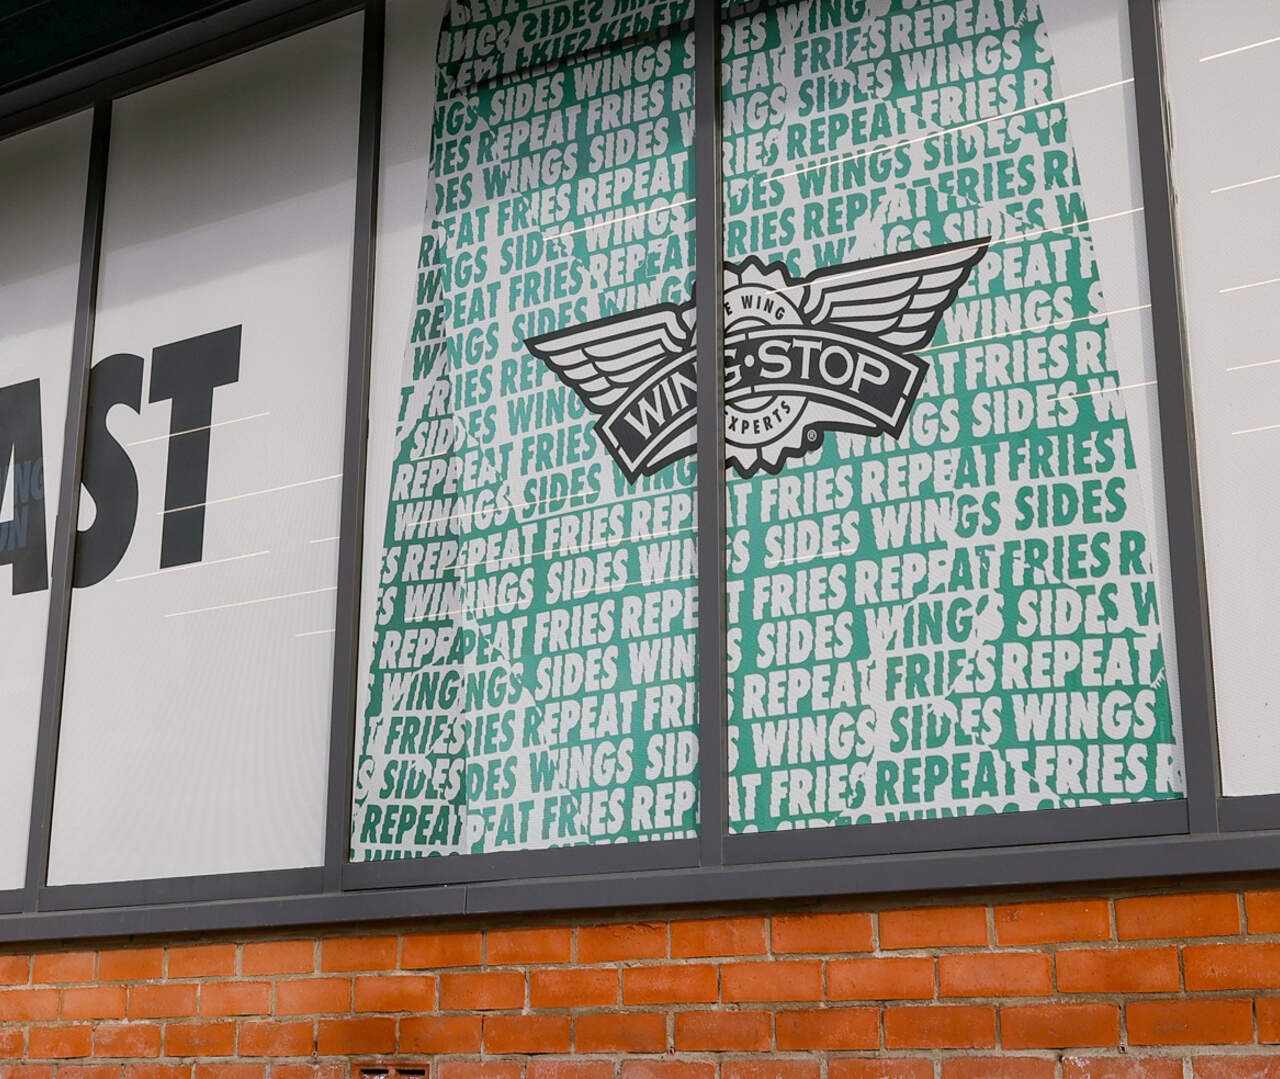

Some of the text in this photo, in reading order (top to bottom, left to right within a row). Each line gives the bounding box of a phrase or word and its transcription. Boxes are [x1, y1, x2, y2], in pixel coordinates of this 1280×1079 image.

[489, 73, 565, 127] SIDES
[573, 42, 672, 100] WINGS
[587, 80, 666, 136] FRIES
[588, 117, 669, 174] SIDES
[902, 29, 1021, 91] WINGS
[576, 151, 687, 217] REPEAT
[741, 294, 786, 321] WING
[942, 286, 1074, 346] WINGS
[519, 420, 597, 477] FRIES
[965, 334, 1071, 391] FRIES
[971, 380, 1080, 438] SIDES
[544, 500, 625, 561] FRIES
[760, 465, 854, 523] FRIES
[546, 548, 629, 605] SIDES
[765, 510, 861, 572] SIDES
[1014, 476, 1128, 532] SIDES
[533, 600, 615, 656] FRIES
[753, 563, 847, 620] FRIES
[536, 646, 618, 702] SIDES
[756, 611, 854, 670] SIDES
[1001, 632, 1163, 690] REPEAT
[752, 709, 876, 768] WINGS
[1012, 689, 1156, 744] WINGS
